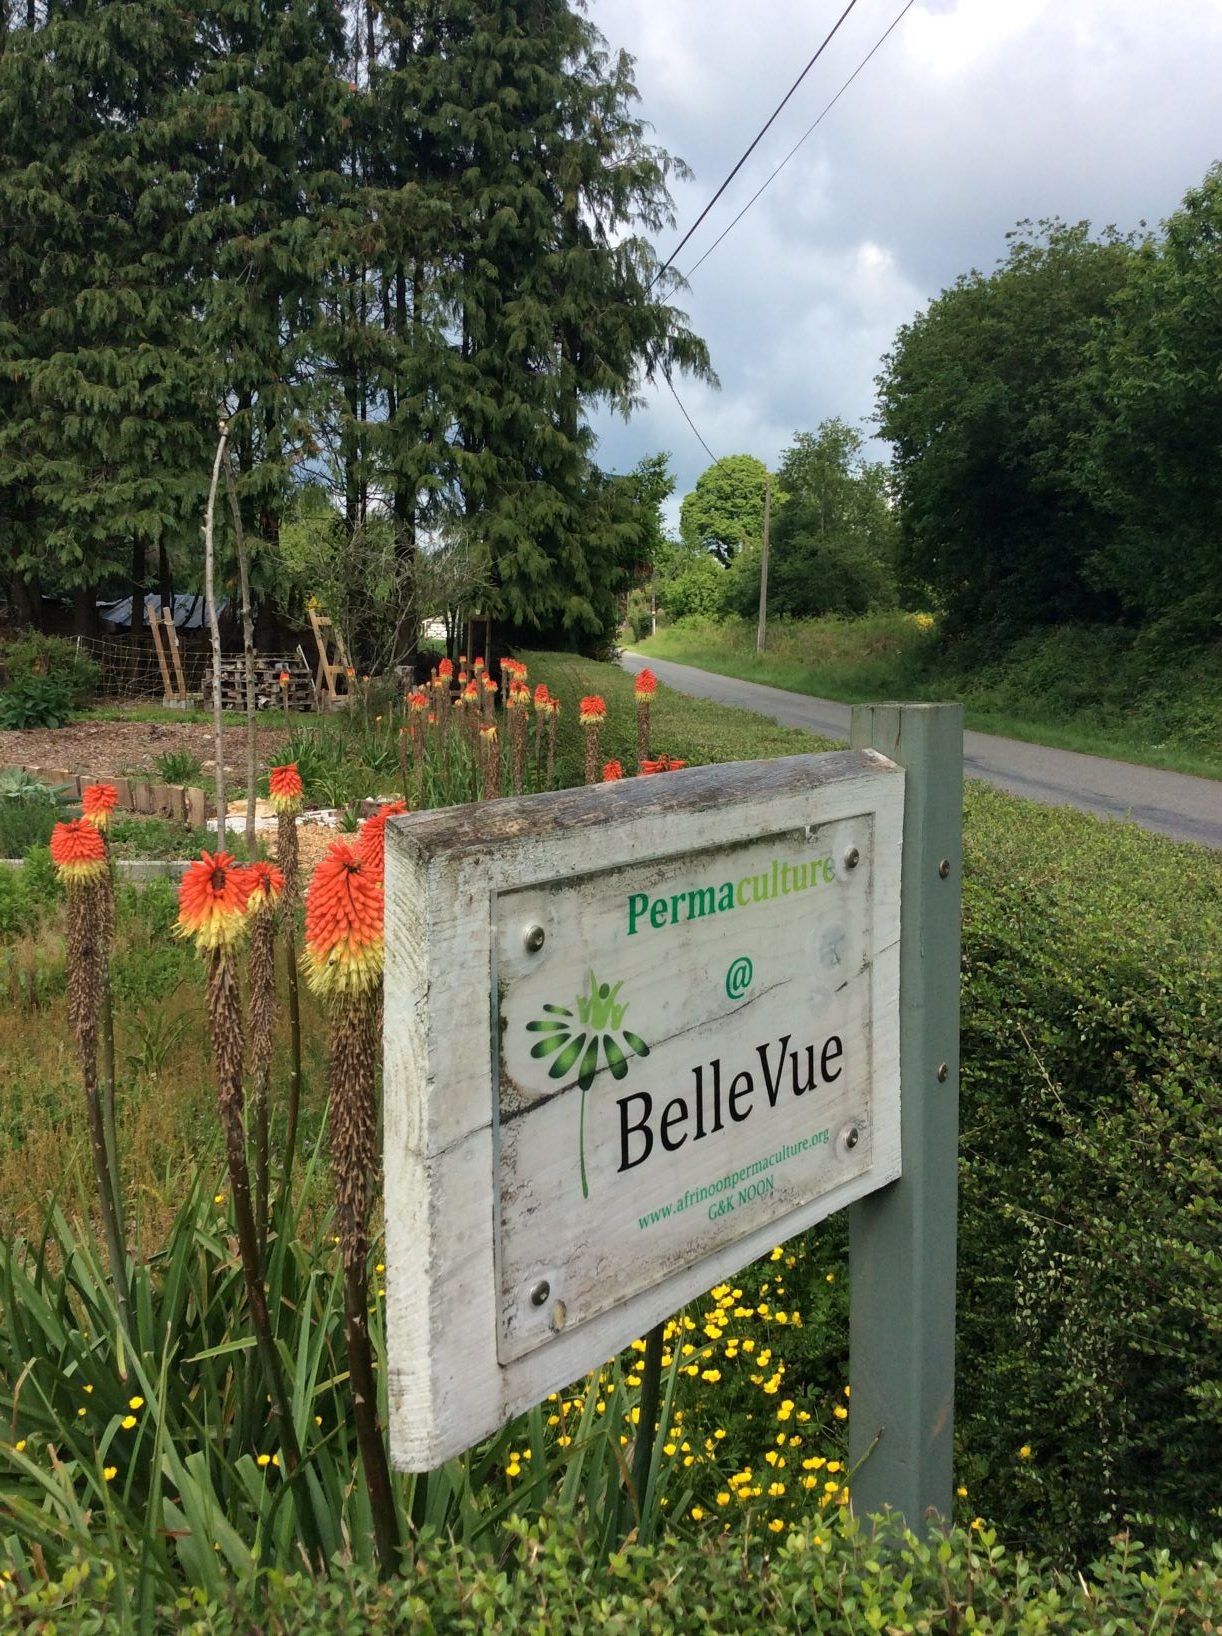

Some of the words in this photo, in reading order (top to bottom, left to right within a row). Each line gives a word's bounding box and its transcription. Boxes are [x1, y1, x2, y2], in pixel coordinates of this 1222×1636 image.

[627, 857, 836, 936] Permaculture
[725, 956, 753, 1000] @
[616, 1034, 843, 1173] BelleVue
[638, 1128, 830, 1230] www.afrinoonpermaculture.org
[708, 1195, 735, 1221] G&K
[738, 1174, 775, 1204] NOON
